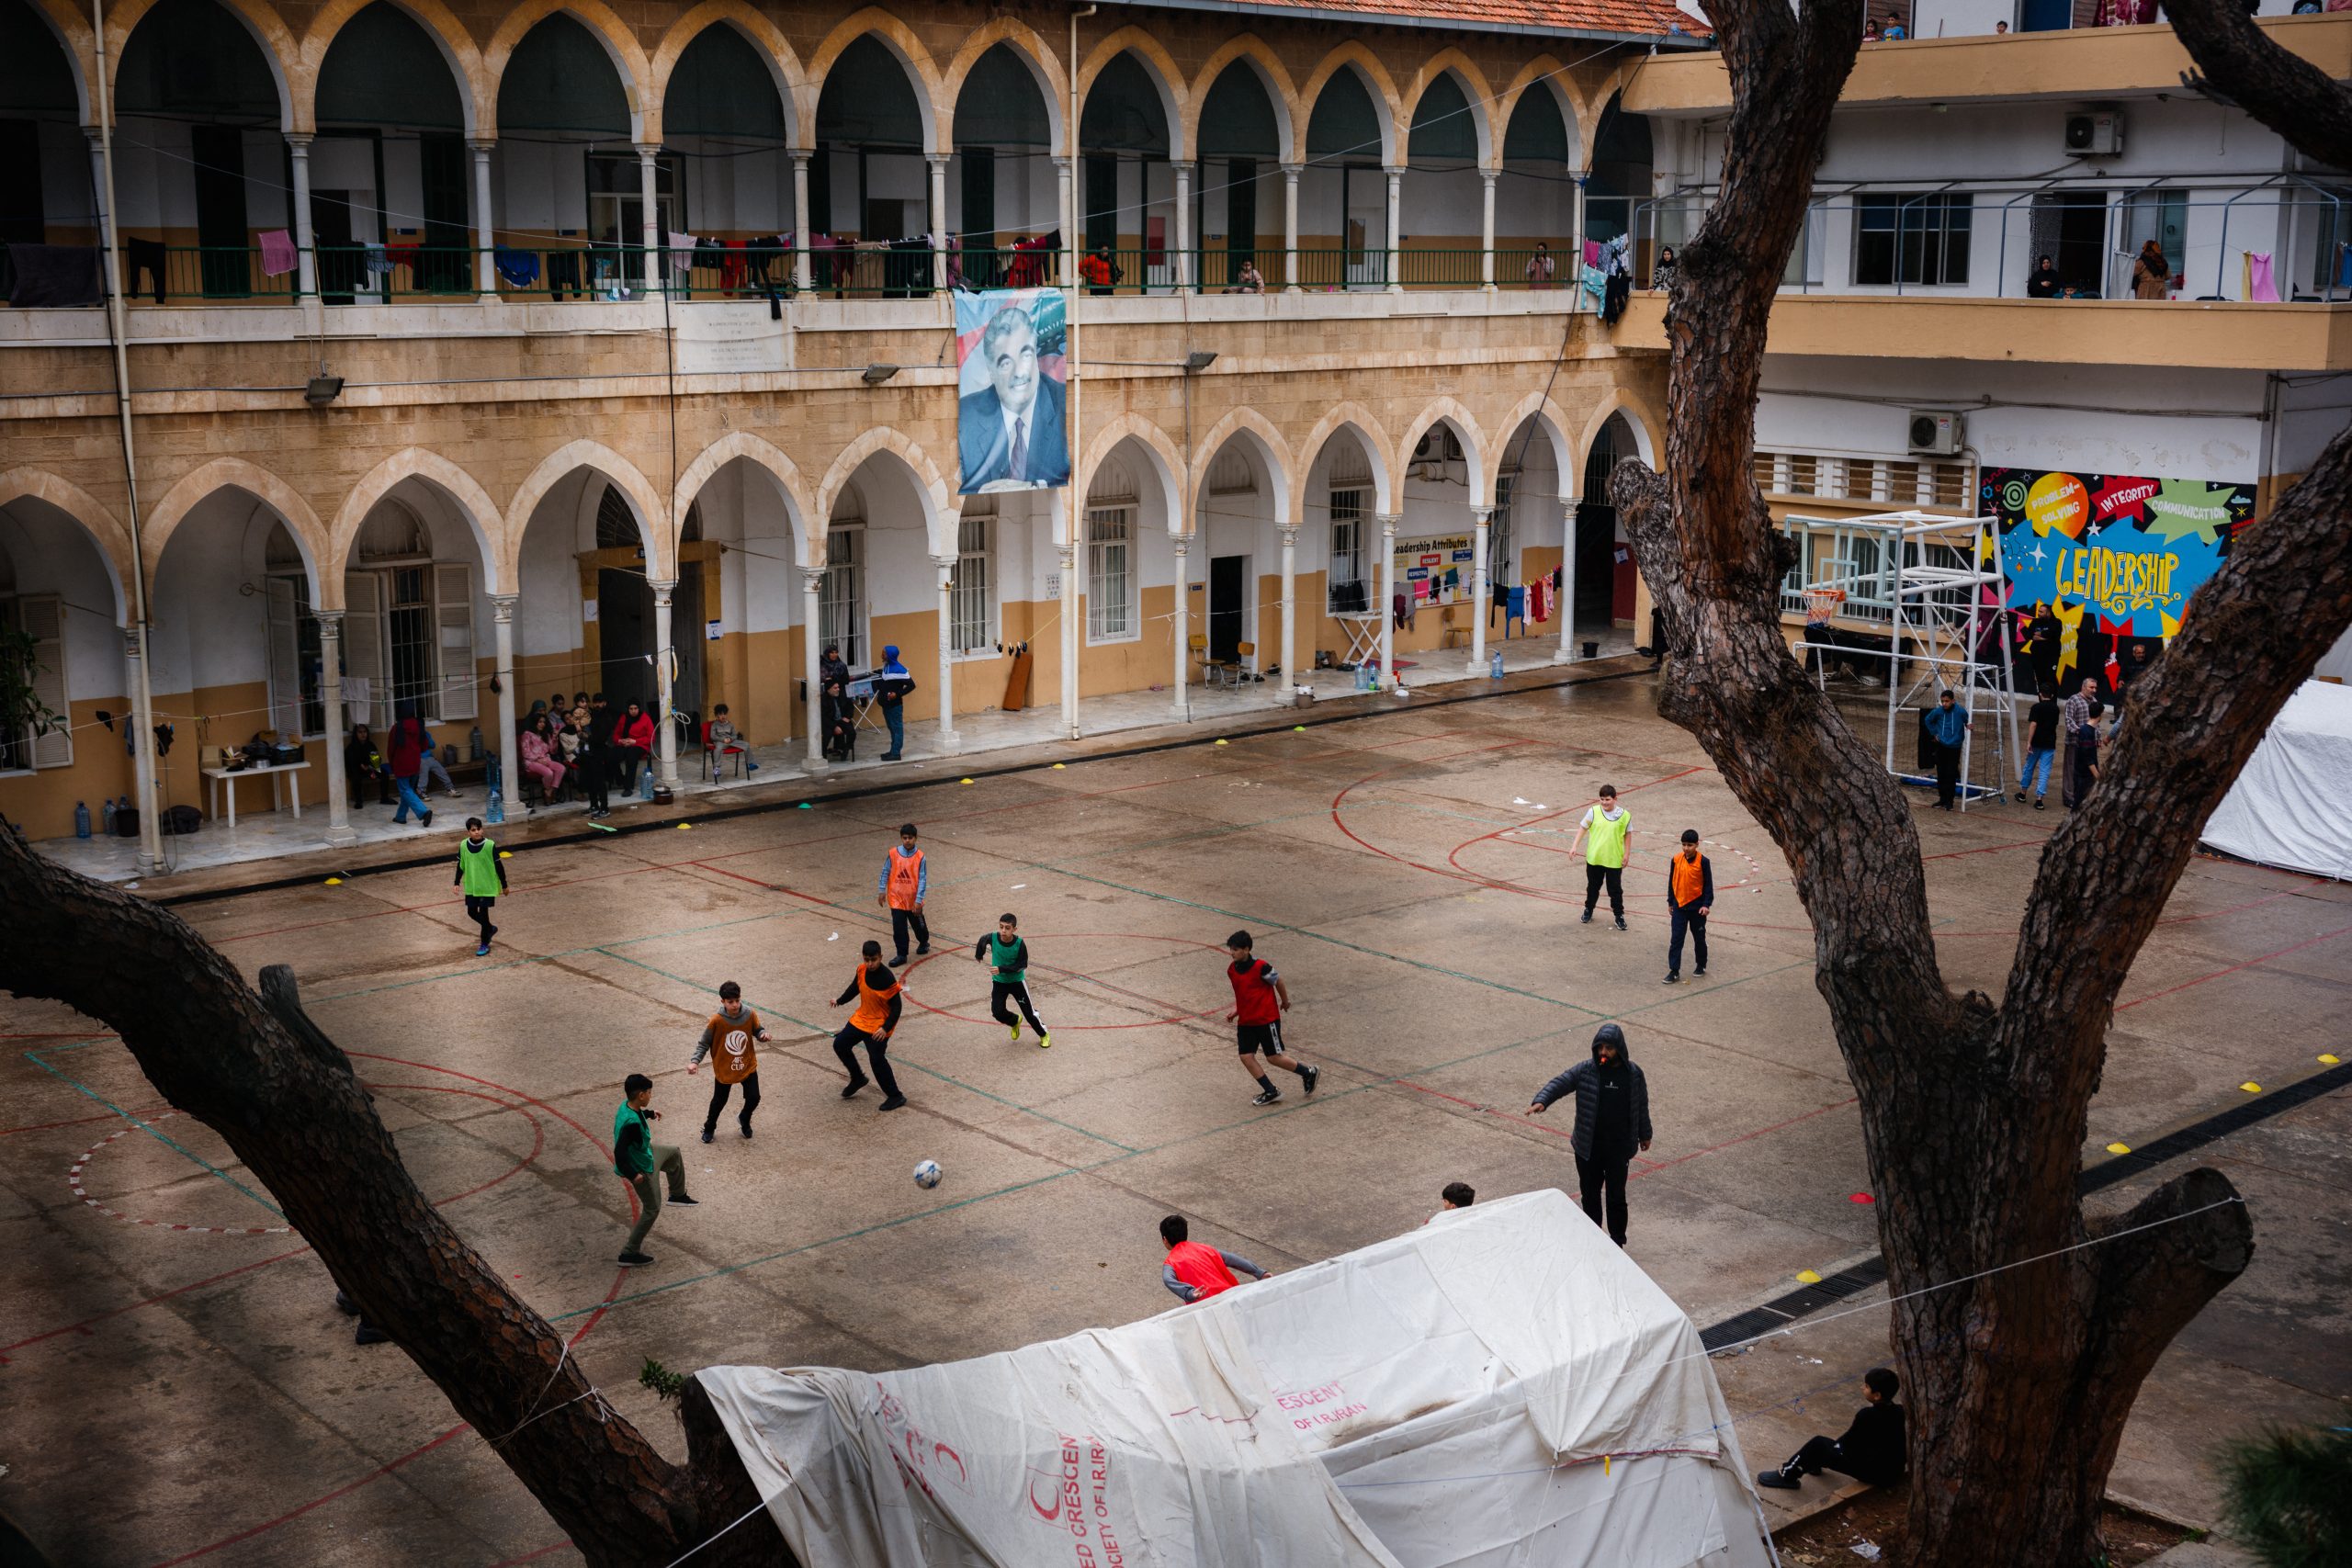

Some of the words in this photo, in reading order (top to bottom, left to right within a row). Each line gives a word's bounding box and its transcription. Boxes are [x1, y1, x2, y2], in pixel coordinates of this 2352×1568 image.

[2031, 482, 2080, 511] PROBLEM-
[2100, 484, 2154, 513] INTEGRITY
[2041, 502, 2080, 525] SOLVING
[2151, 500, 2225, 521] COMMUNICATION
[1394, 540, 1430, 554] eadership
[1431, 537, 1468, 551] Attributes
[2055, 547, 2179, 602] LEADERSHIP
[730, 1063, 744, 1071] CUP
[1277, 1381, 1345, 1411] ESCENT
[1294, 1418, 1313, 1430] OF
[1058, 1435, 1088, 1538] CRESCEN
[1094, 1495, 1108, 1517] OF
[1075, 1543, 1097, 1568] ED
[1097, 1521, 1125, 1568] CIETY
